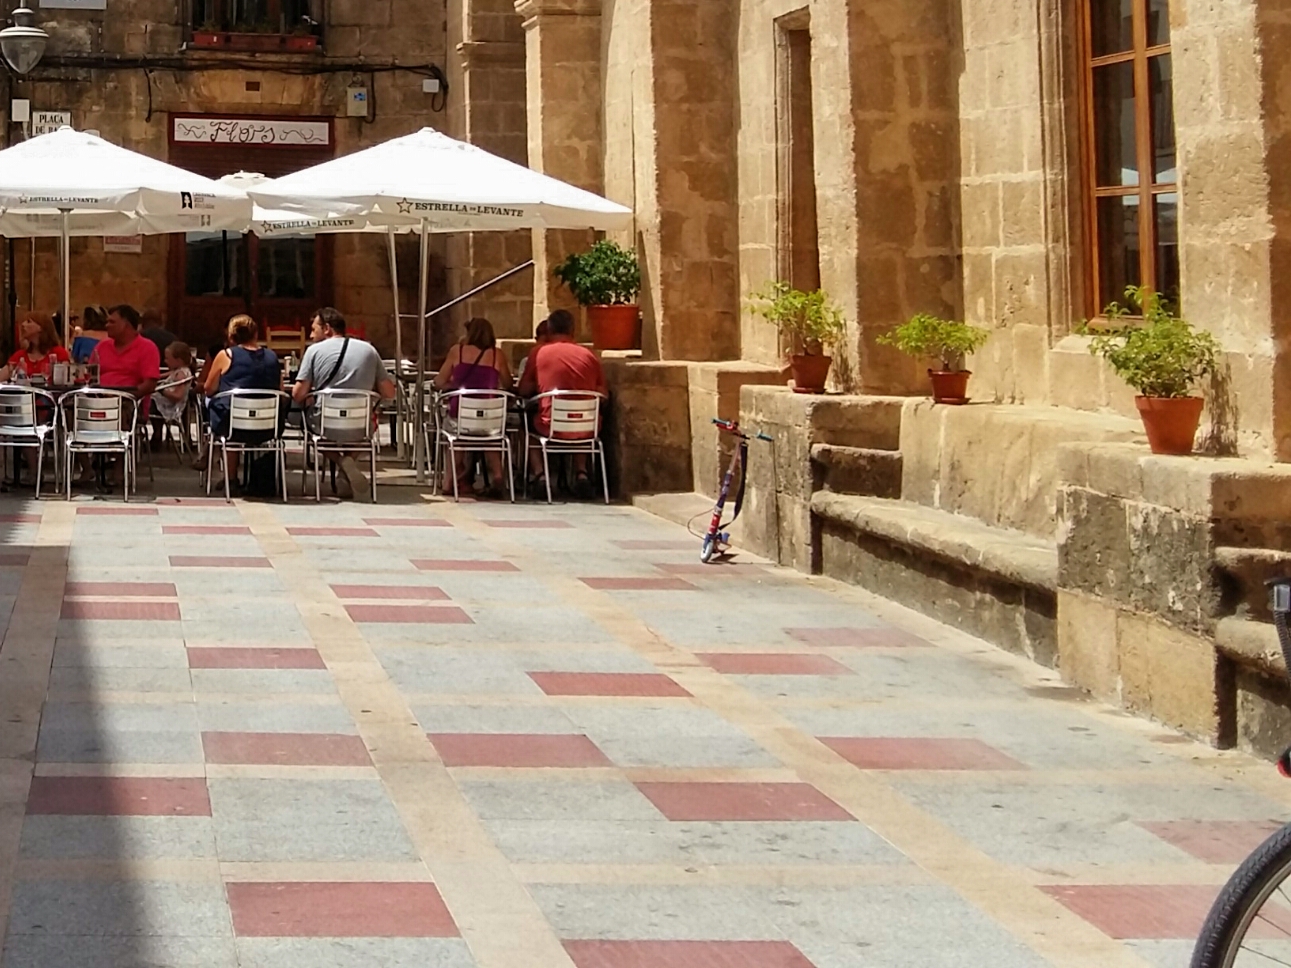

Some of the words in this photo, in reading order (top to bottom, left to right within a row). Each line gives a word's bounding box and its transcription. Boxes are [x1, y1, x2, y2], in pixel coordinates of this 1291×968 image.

[210, 121, 275, 143] Flors
[414, 202, 468, 213] ESTRELLA
[477, 206, 524, 217] LEVANTE
[273, 219, 310, 229] ESTRELLA
[317, 219, 354, 227] LEVANTE
